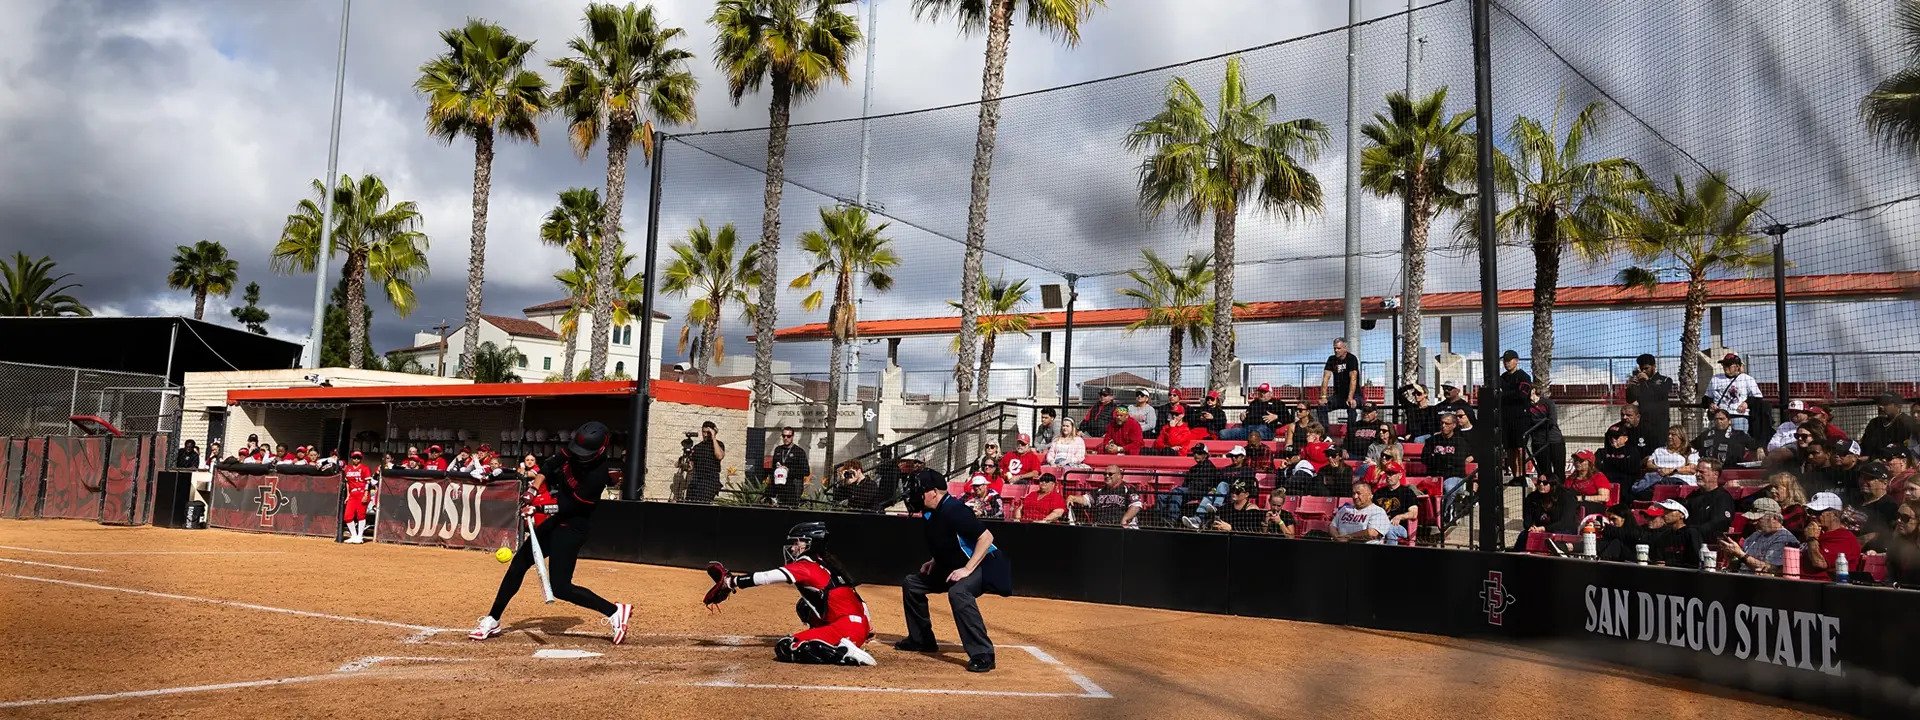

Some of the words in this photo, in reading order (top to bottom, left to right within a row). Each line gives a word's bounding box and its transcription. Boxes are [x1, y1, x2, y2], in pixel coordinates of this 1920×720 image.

[406, 482, 486, 541] SDSU
[1340, 512, 1368, 523] CSUN
[1584, 584, 1630, 640] SAN
[1636, 591, 1728, 656] DIEGO
[1734, 603, 1842, 677] STATE
